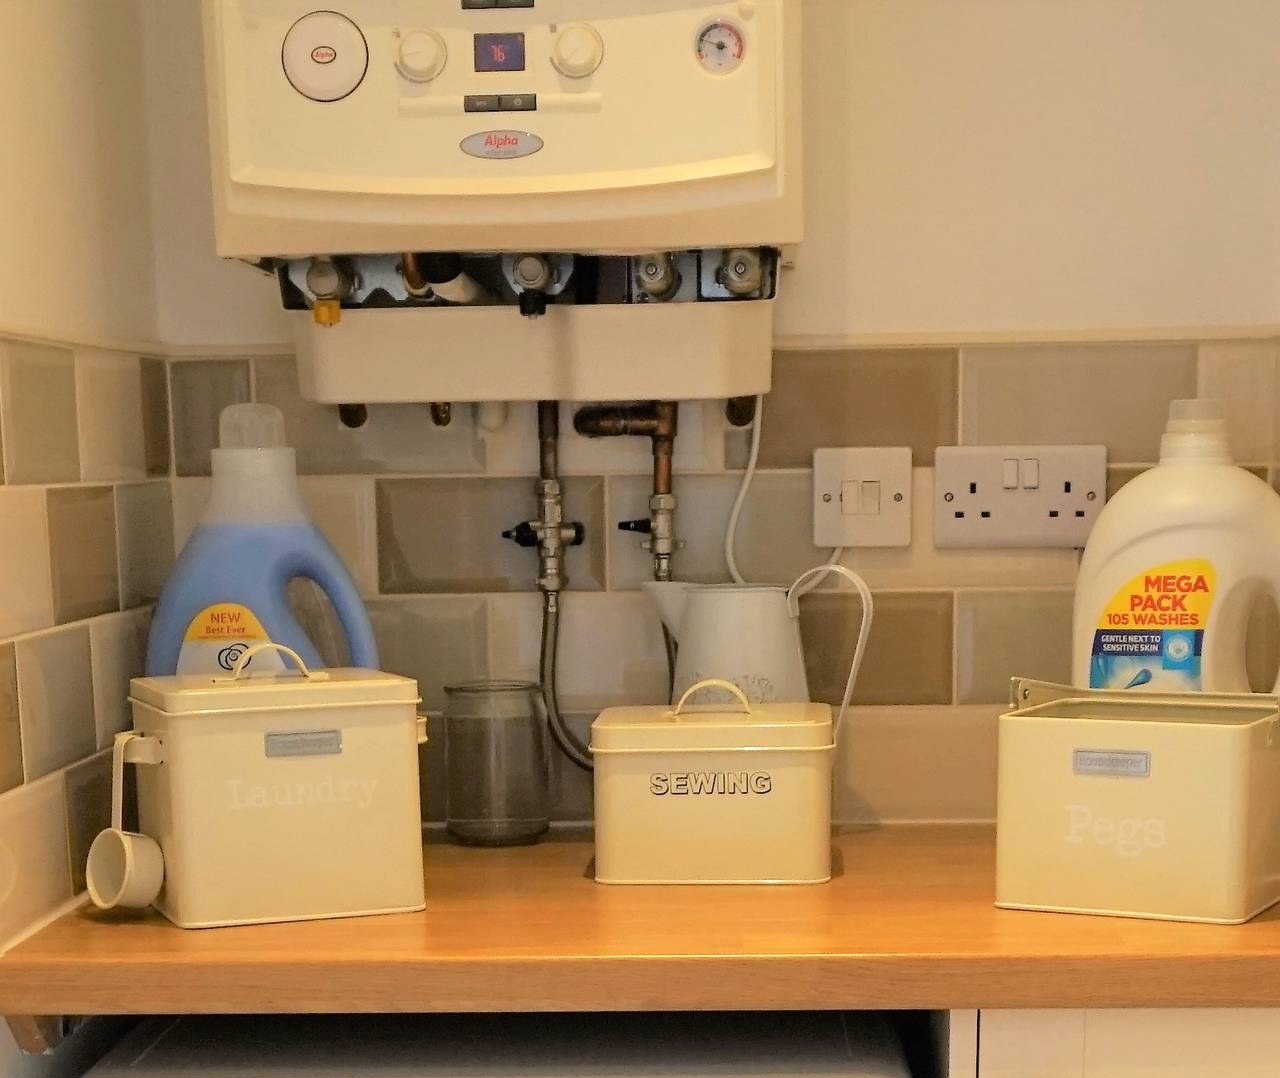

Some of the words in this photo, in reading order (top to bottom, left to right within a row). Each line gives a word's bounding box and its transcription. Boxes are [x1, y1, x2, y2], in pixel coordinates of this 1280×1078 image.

[484, 134, 519, 149] Alpha
[1144, 575, 1210, 593] MEGA
[1130, 594, 1187, 612] PACK
[210, 613, 241, 624] NEW
[1107, 613, 1129, 625] 105
[1133, 613, 1199, 625] WASHES
[205, 625, 224, 634] Best
[1101, 635, 1127, 643] GENTLE
[650, 771, 771, 795] SEWING
[226, 774, 378, 810] Laundry
[1064, 804, 1166, 856] Pegs
